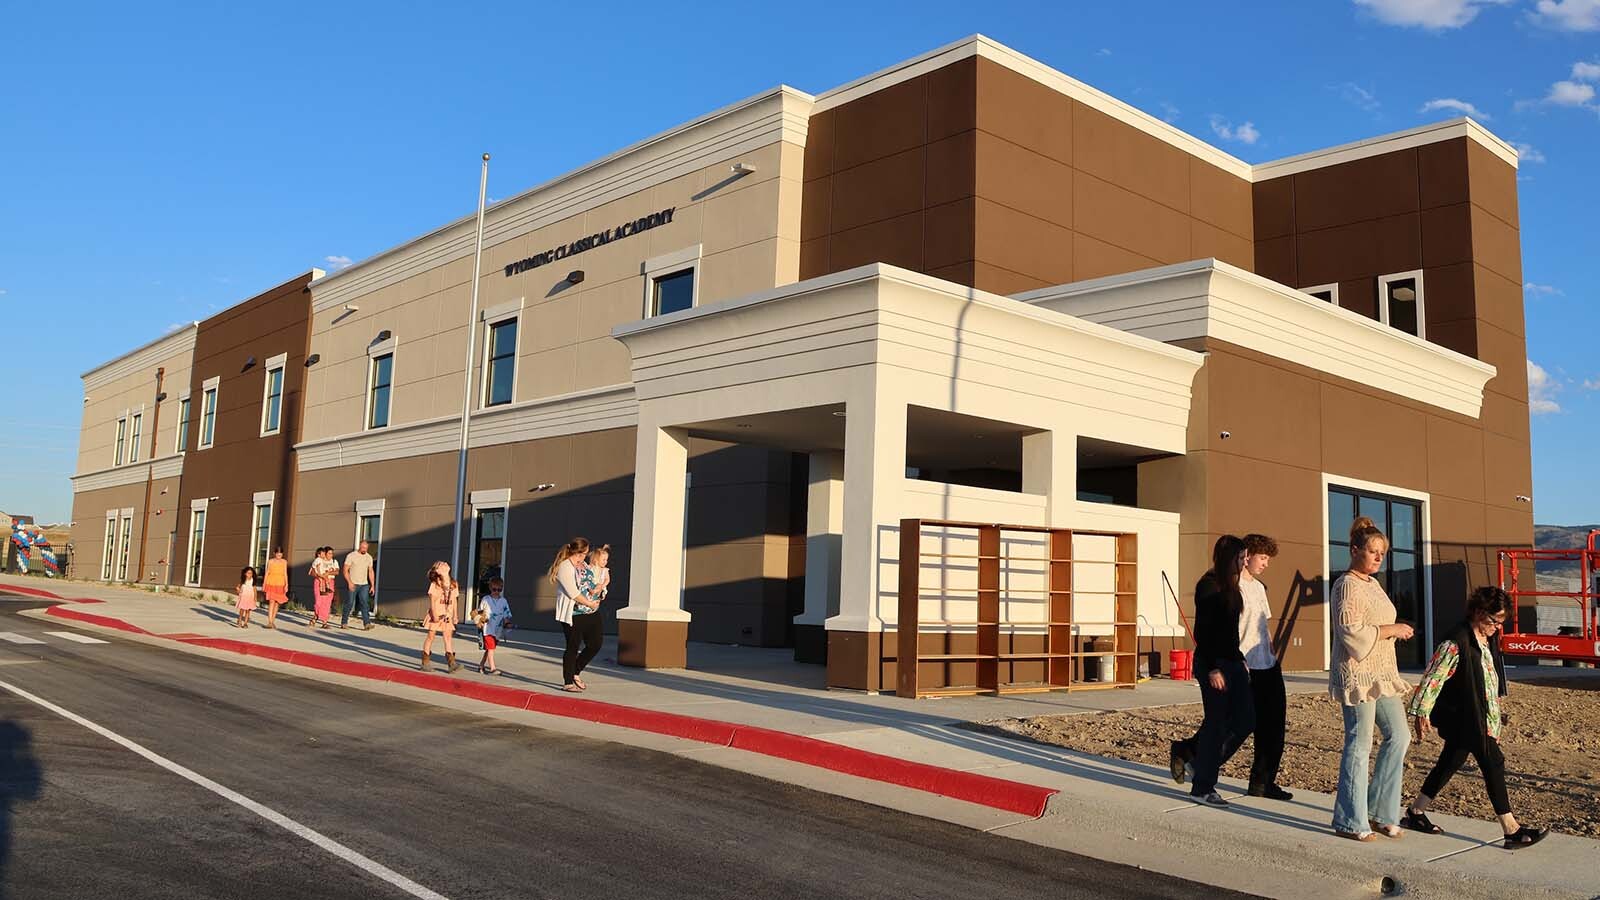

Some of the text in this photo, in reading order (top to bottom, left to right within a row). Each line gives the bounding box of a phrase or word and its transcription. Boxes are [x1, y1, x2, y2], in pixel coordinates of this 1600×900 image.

[504, 206, 676, 277] WYOMING CLASSICAL ACADEMY
[1508, 641, 1560, 652] SKYJACK
